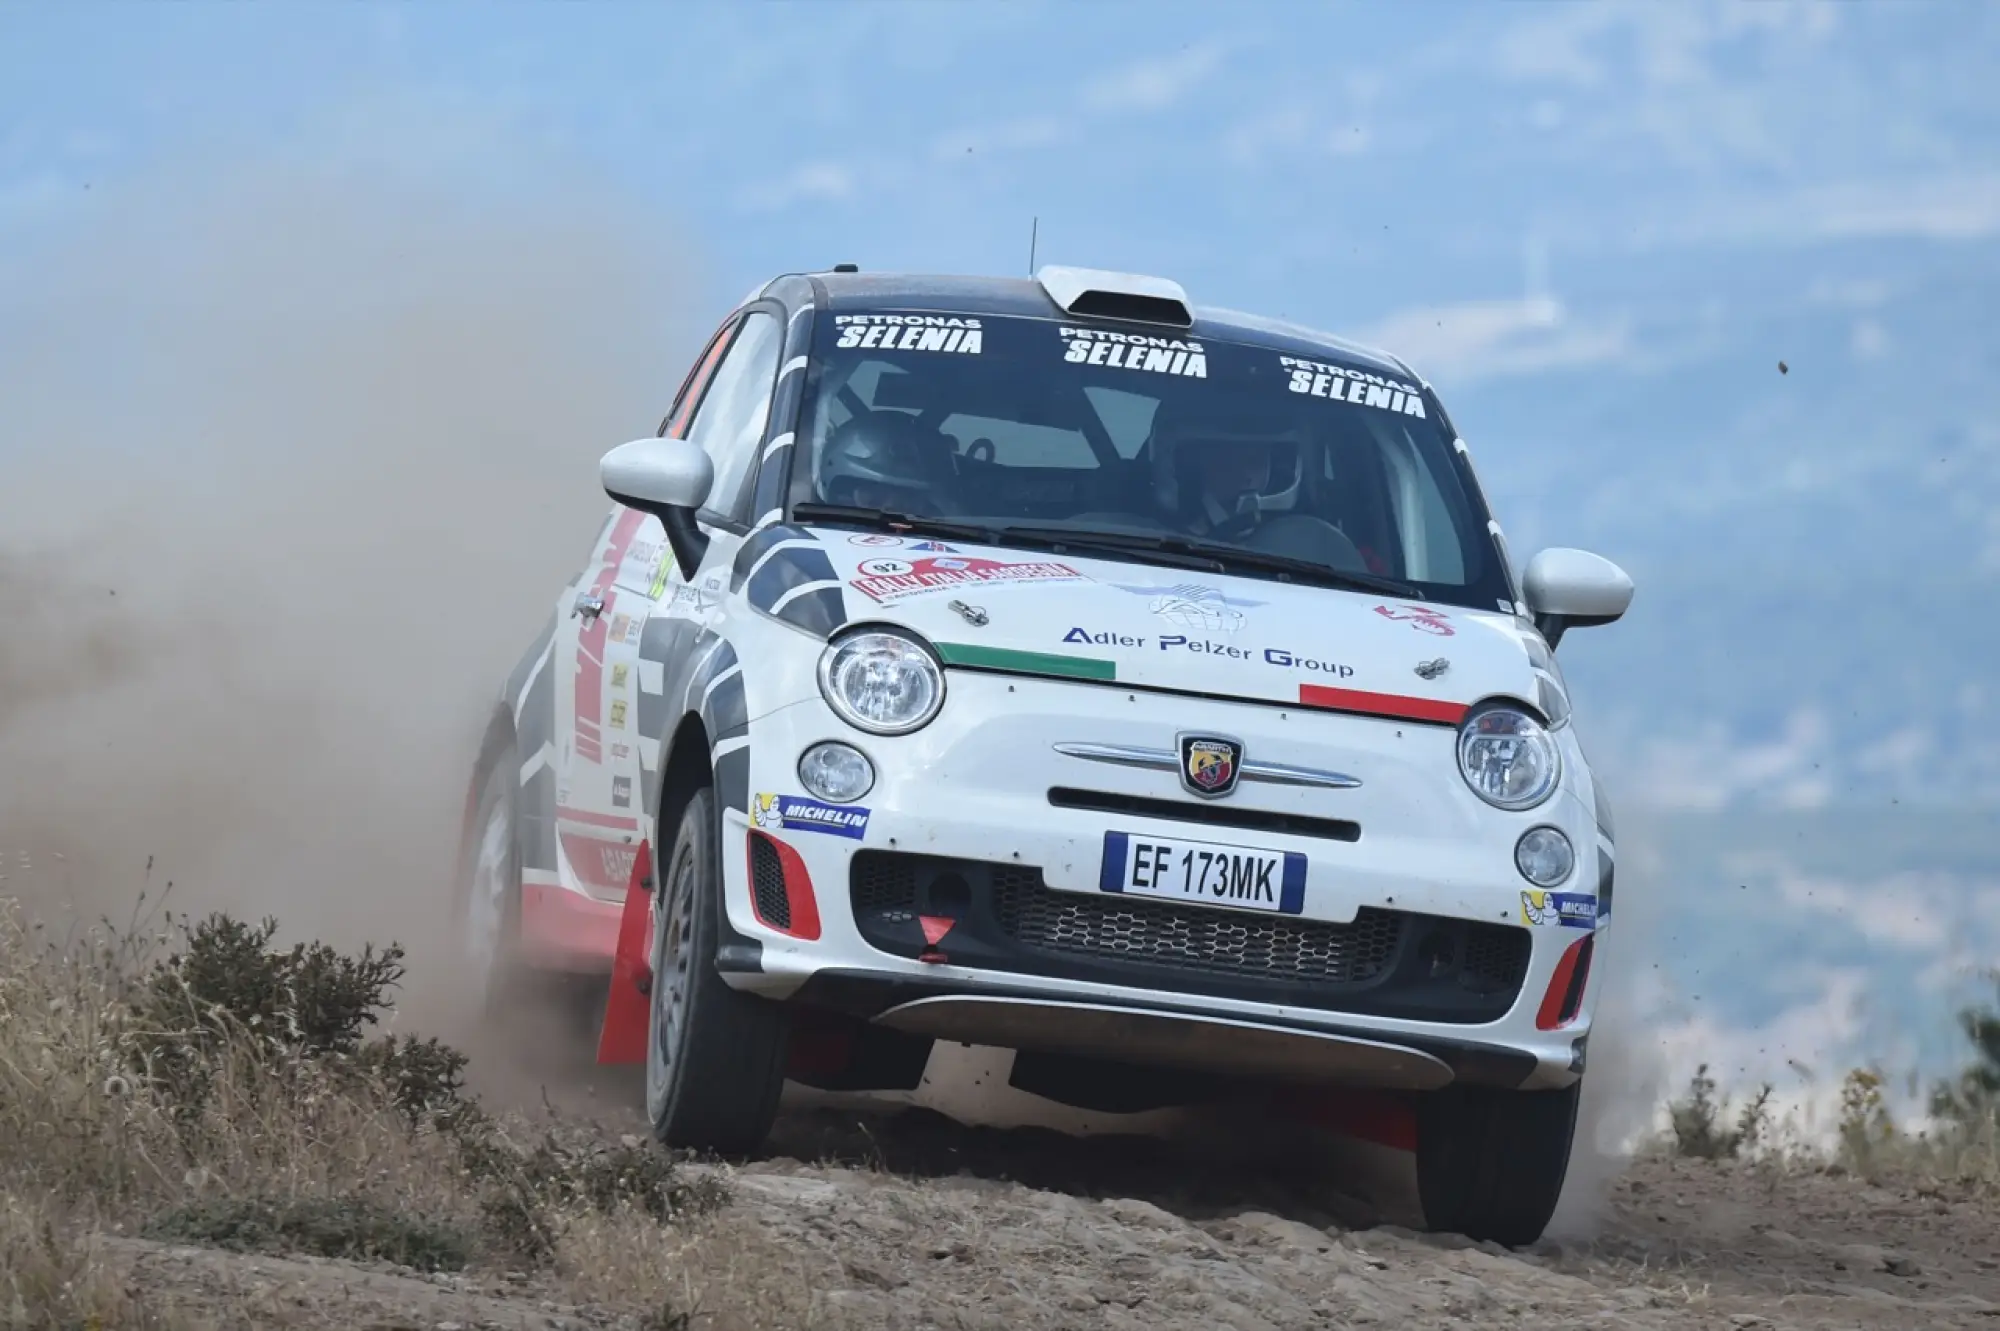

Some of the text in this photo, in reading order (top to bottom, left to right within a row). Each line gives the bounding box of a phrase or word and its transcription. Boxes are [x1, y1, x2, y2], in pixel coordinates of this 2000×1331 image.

[835, 314, 982, 329] PETRONAS
[836, 325, 983, 354] SELENIA
[1059, 327, 1204, 353] PETRONAS
[1063, 339, 1208, 379] SELENIA
[1279, 355, 1420, 396] PETRONAS
[1288, 369, 1427, 420] SELENIA
[873, 563, 903, 573] 92
[860, 574, 928, 597] RALLY
[1062, 626, 1354, 679] Adler Pelzer Group
[785, 803, 868, 828] MICHELIN
[1131, 843, 1278, 902] EF 173MK
